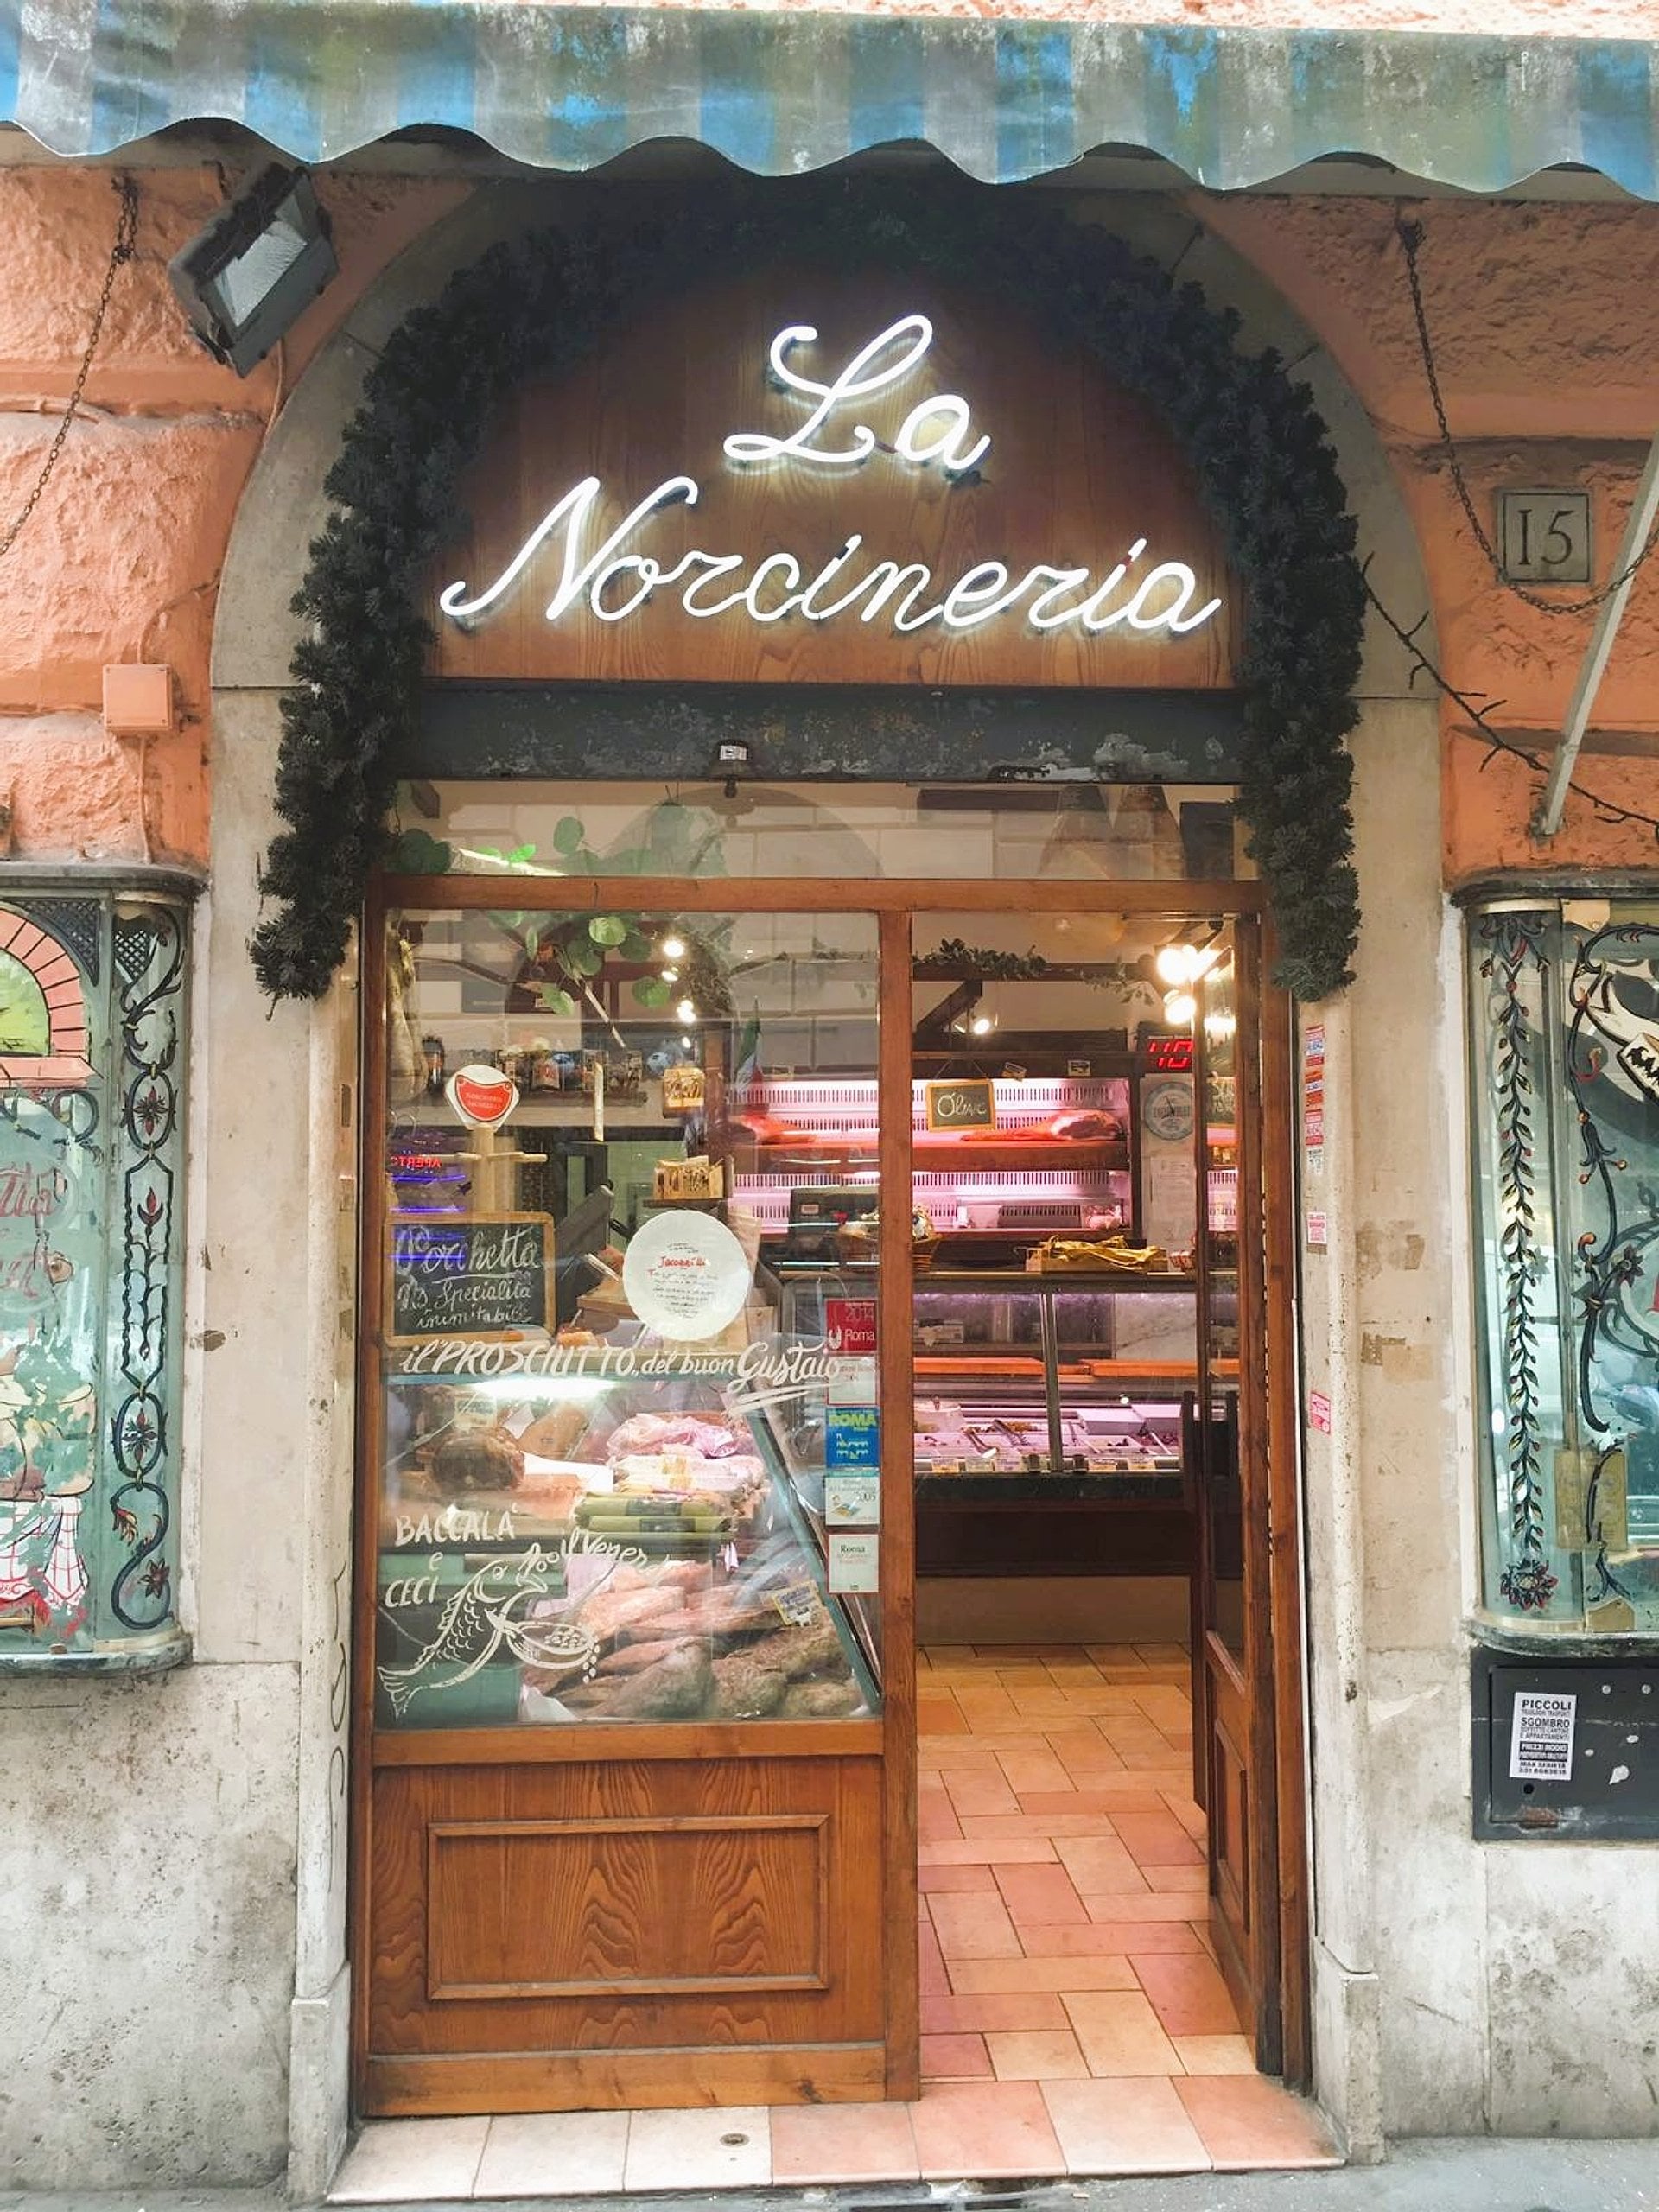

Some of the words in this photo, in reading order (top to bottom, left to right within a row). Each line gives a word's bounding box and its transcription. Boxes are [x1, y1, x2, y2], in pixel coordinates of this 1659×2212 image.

[722, 314, 991, 470] La
[1518, 509, 1574, 564] 15
[439, 475, 1222, 633] Norcineria
[397, 1225, 541, 1275] Porchetta
[844, 1328, 875, 1341] Roma
[641, 1353, 675, 1375] del
[679, 1353, 734, 1376] buon
[840, 1544, 867, 1554] Roma
[429, 1552, 444, 1572] e
[385, 1575, 440, 1608] CECI
[1522, 1700, 1572, 1710] PICCOLI
[1522, 1717, 1570, 1728] SGOMBRO
